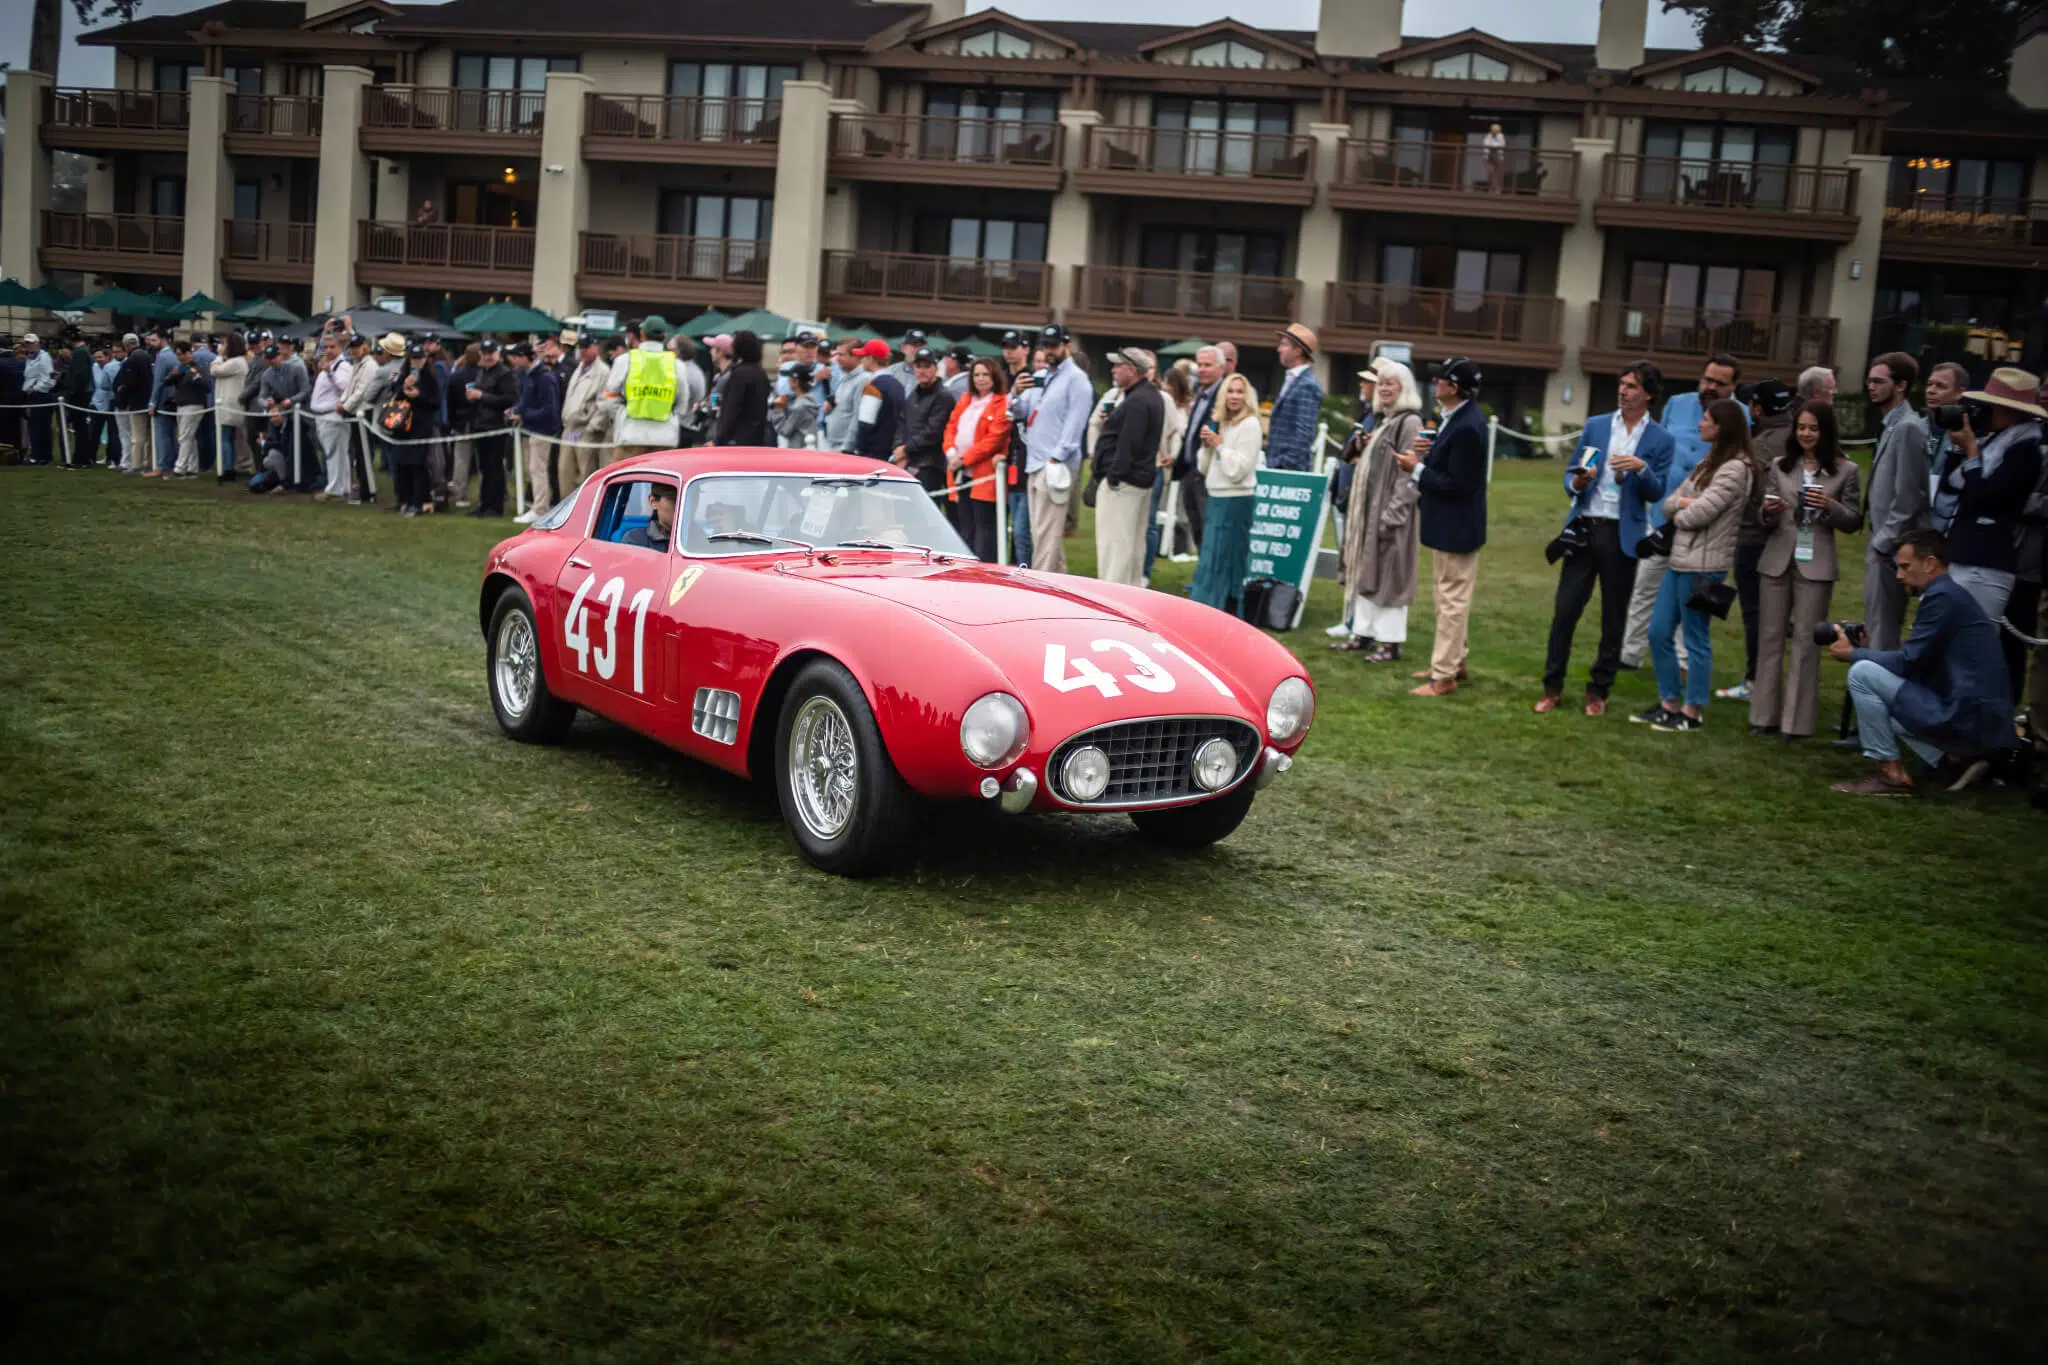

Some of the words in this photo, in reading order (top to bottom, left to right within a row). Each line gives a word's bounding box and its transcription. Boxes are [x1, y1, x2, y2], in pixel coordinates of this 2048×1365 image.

[1255, 484, 1269, 498] NO
[1269, 485, 1312, 502] BLANKETS
[1255, 502, 1269, 516] OR
[1270, 504, 1302, 520] CHAIRS
[1286, 525, 1302, 539] ON
[1268, 542, 1292, 557] FIELD
[1251, 559, 1275, 574] UNTIL
[565, 572, 655, 694] 431
[1043, 639, 1235, 698] 431
